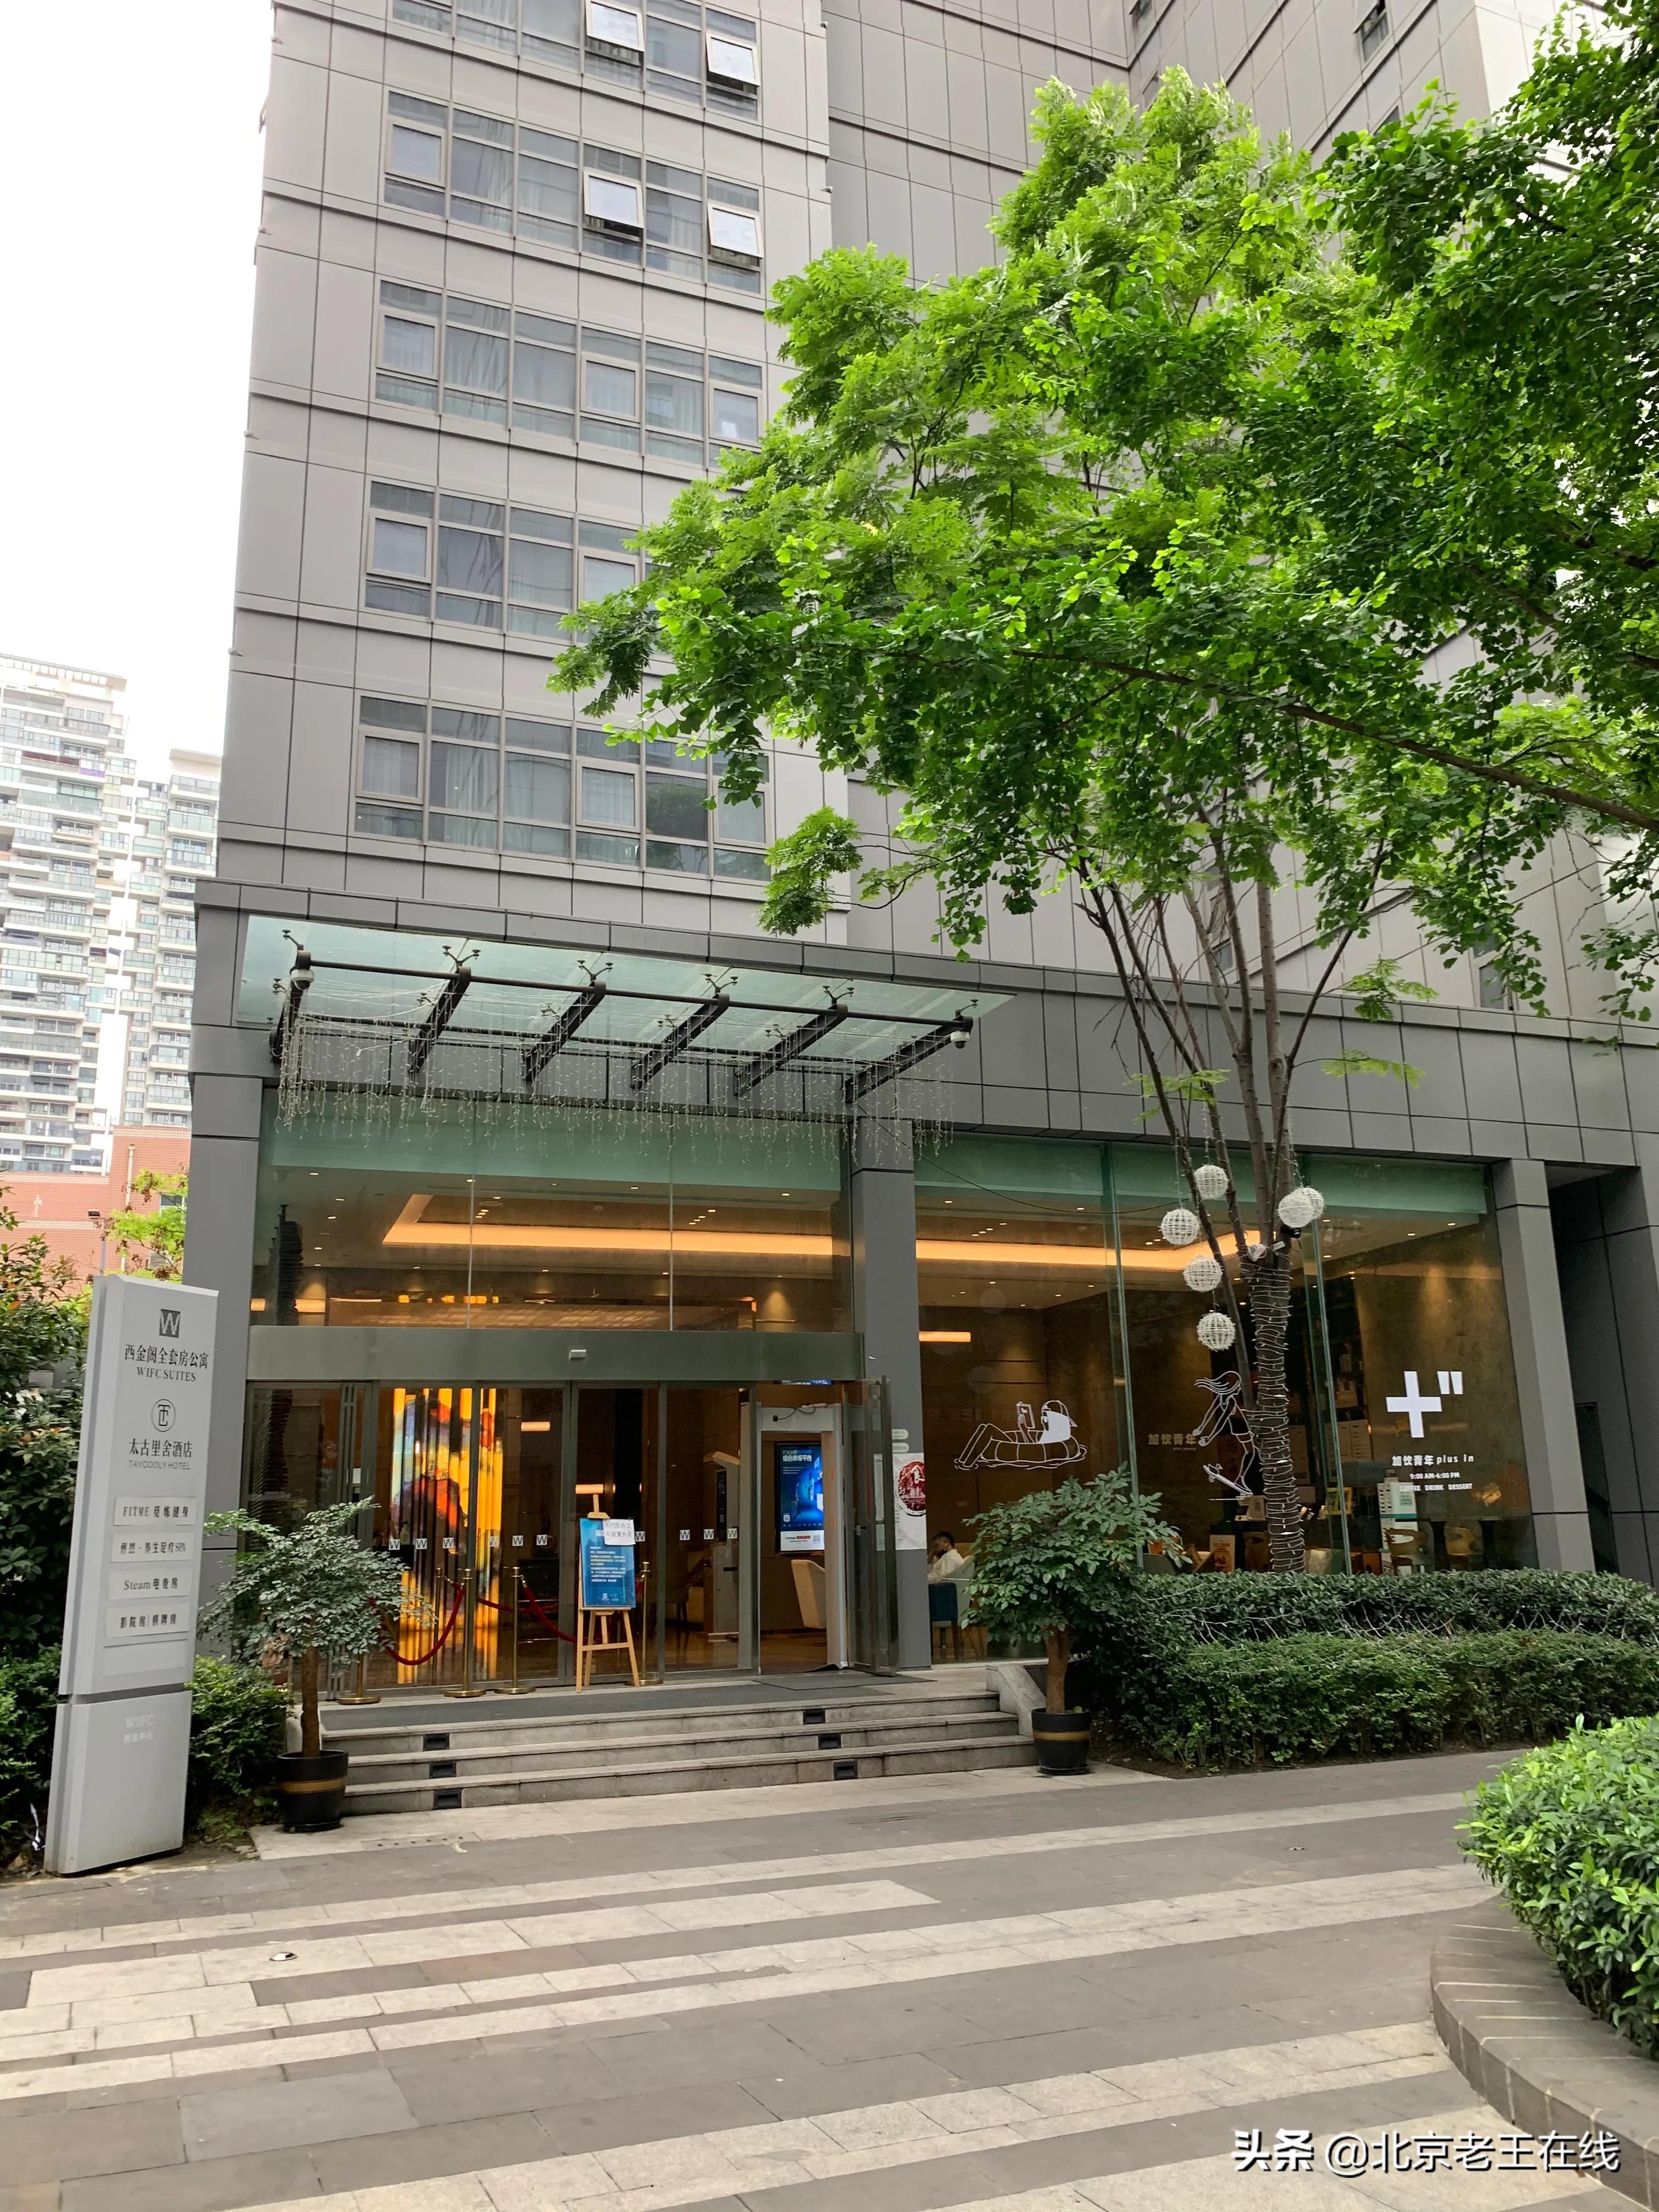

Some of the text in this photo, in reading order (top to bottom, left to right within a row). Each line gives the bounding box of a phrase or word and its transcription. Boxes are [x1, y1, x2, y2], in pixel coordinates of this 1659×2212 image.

[125, 1344, 209, 1369] 西金阁全套房公寓
[137, 1367, 196, 1381] WIFC SUITES
[128, 1438, 193, 1458] 太古里舍酒店
[1436, 1454, 1458, 1465] plus
[1463, 1454, 1474, 1463] in
